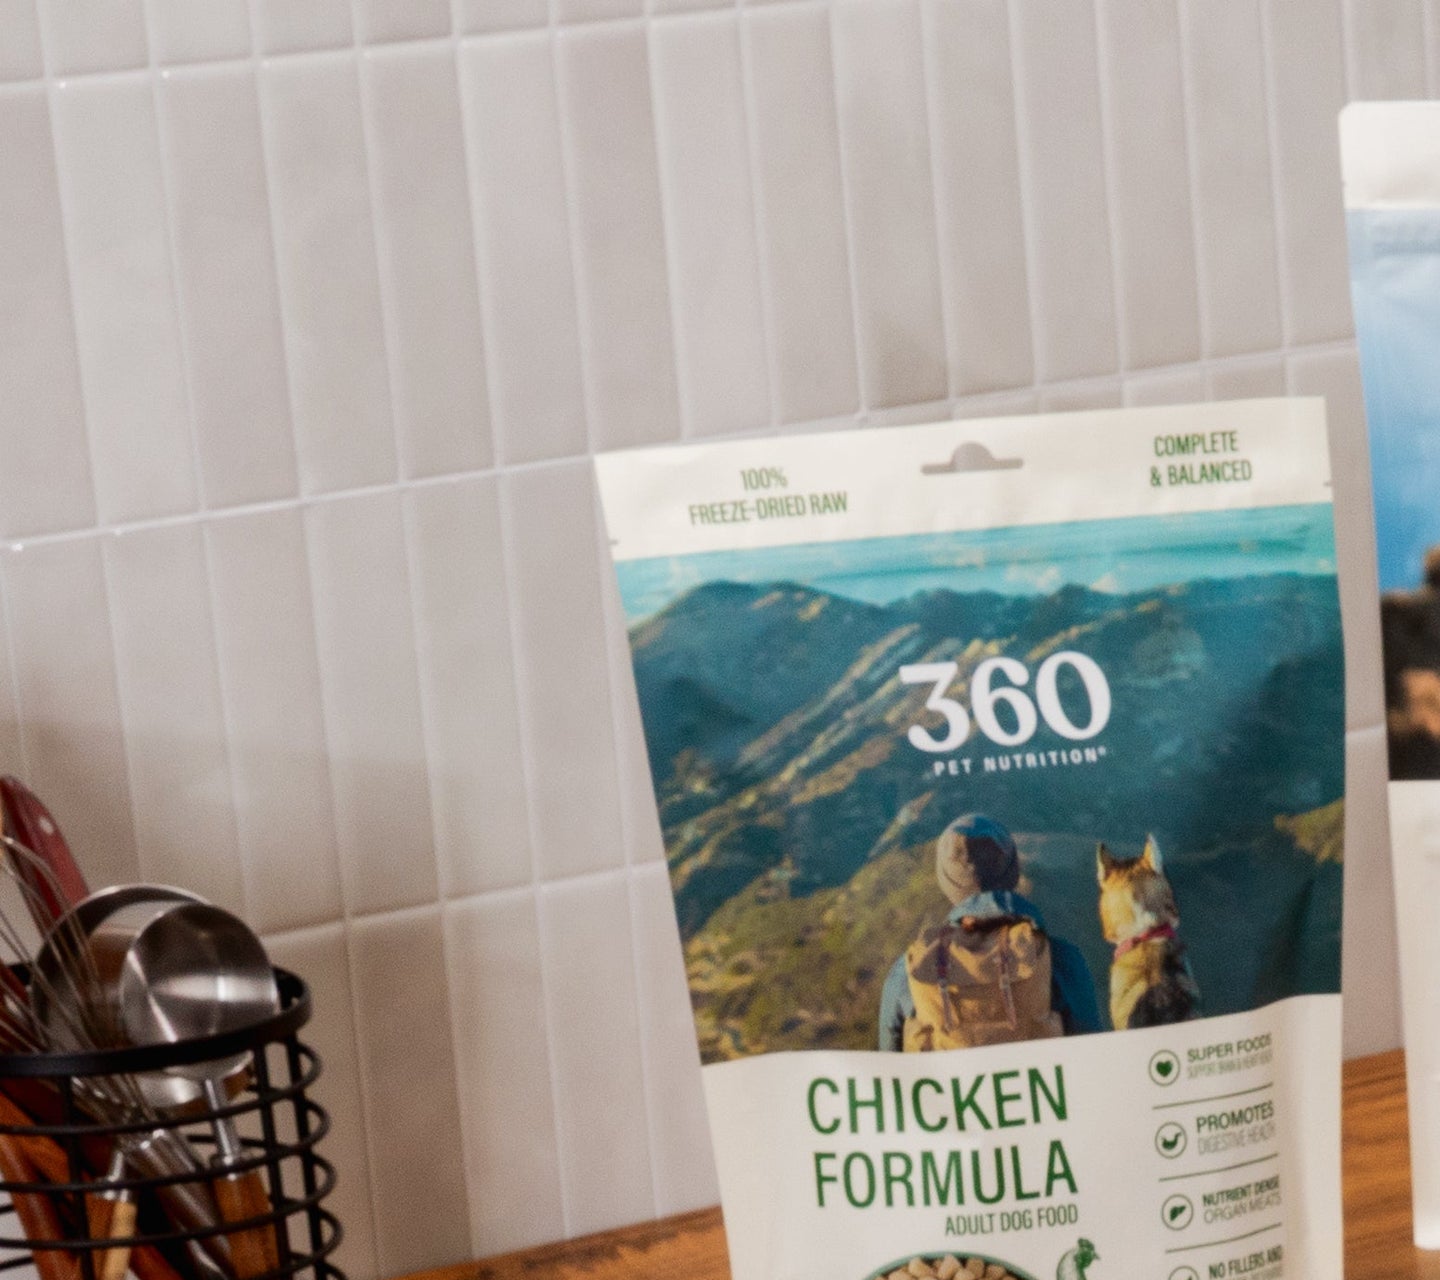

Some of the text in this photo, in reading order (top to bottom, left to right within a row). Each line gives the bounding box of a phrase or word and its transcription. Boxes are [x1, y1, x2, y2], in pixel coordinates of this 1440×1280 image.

[1154, 430, 1239, 457] COMPLETE
[740, 466, 788, 491] 100%
[1150, 458, 1252, 487] & BALANCED
[688, 491, 848, 526] FREEZE-DRIED RAW
[899, 650, 1112, 753] 360
[933, 758, 972, 776] PET
[1187, 1043, 1233, 1062] SUPER
[807, 1064, 1068, 1135] CHICKEN
[1196, 1099, 1275, 1133] PROMOTES
[813, 1139, 1079, 1209] FORMULA
[945, 1203, 1079, 1237] ADULT DOG FOOD
[1209, 1263, 1226, 1280] NO
[1228, 1251, 1265, 1276] FILLERS
